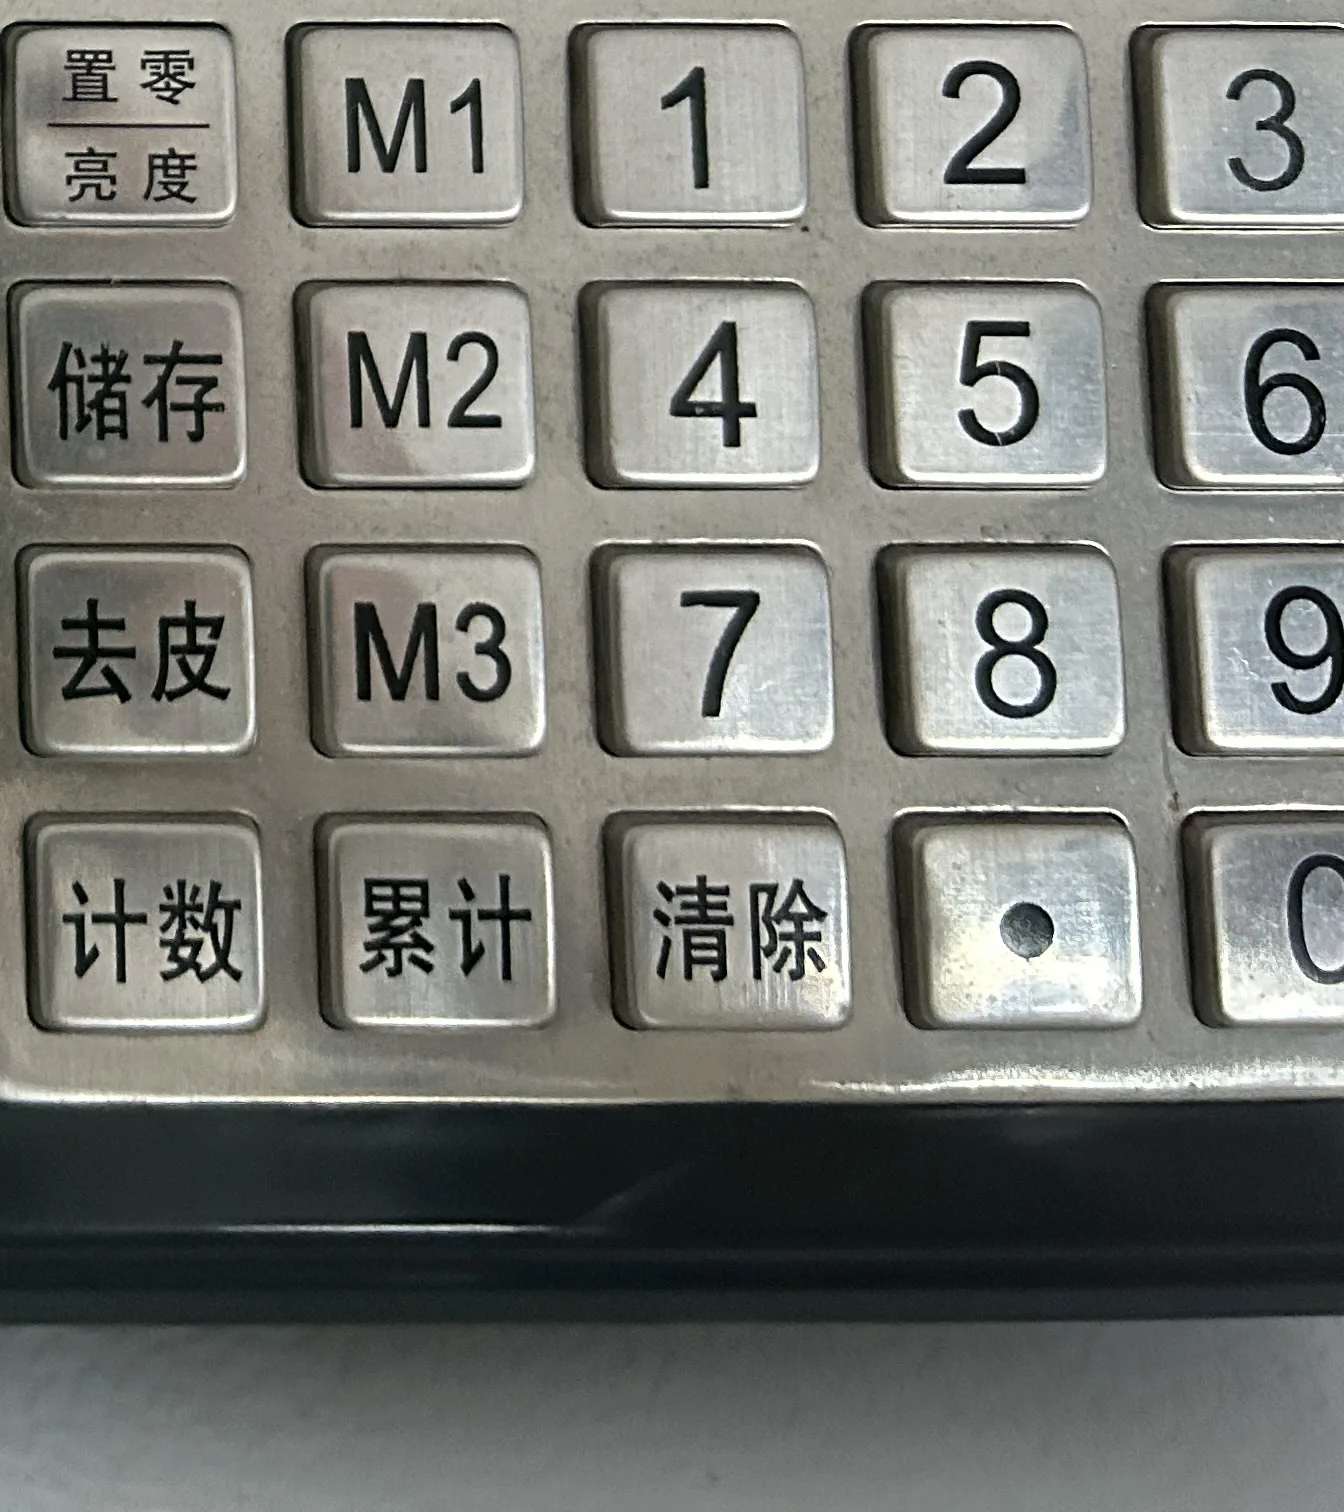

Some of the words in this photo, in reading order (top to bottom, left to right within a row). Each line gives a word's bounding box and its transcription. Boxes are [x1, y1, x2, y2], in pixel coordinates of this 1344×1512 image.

[62, 48, 198, 107] 置零
[345, 77, 485, 174] M1
[660, 65, 710, 189] 1
[941, 59, 1027, 185] 2
[1226, 68, 1306, 192] 3
[64, 146, 198, 204] 亮度
[48, 340, 226, 443] 储存
[347, 330, 503, 430] M2
[669, 320, 758, 448] 4
[957, 320, 1040, 447] 5
[1243, 328, 1327, 456] 6
[52, 597, 232, 704] 去皮
[353, 600, 513, 703] M3
[679, 590, 761, 718] 7
[974, 588, 1058, 719] 8
[1264, 585, 1344, 715] 9
[62, 877, 243, 984] 计数
[358, 874, 533, 982] 累计
[652, 874, 829, 983] 清除
